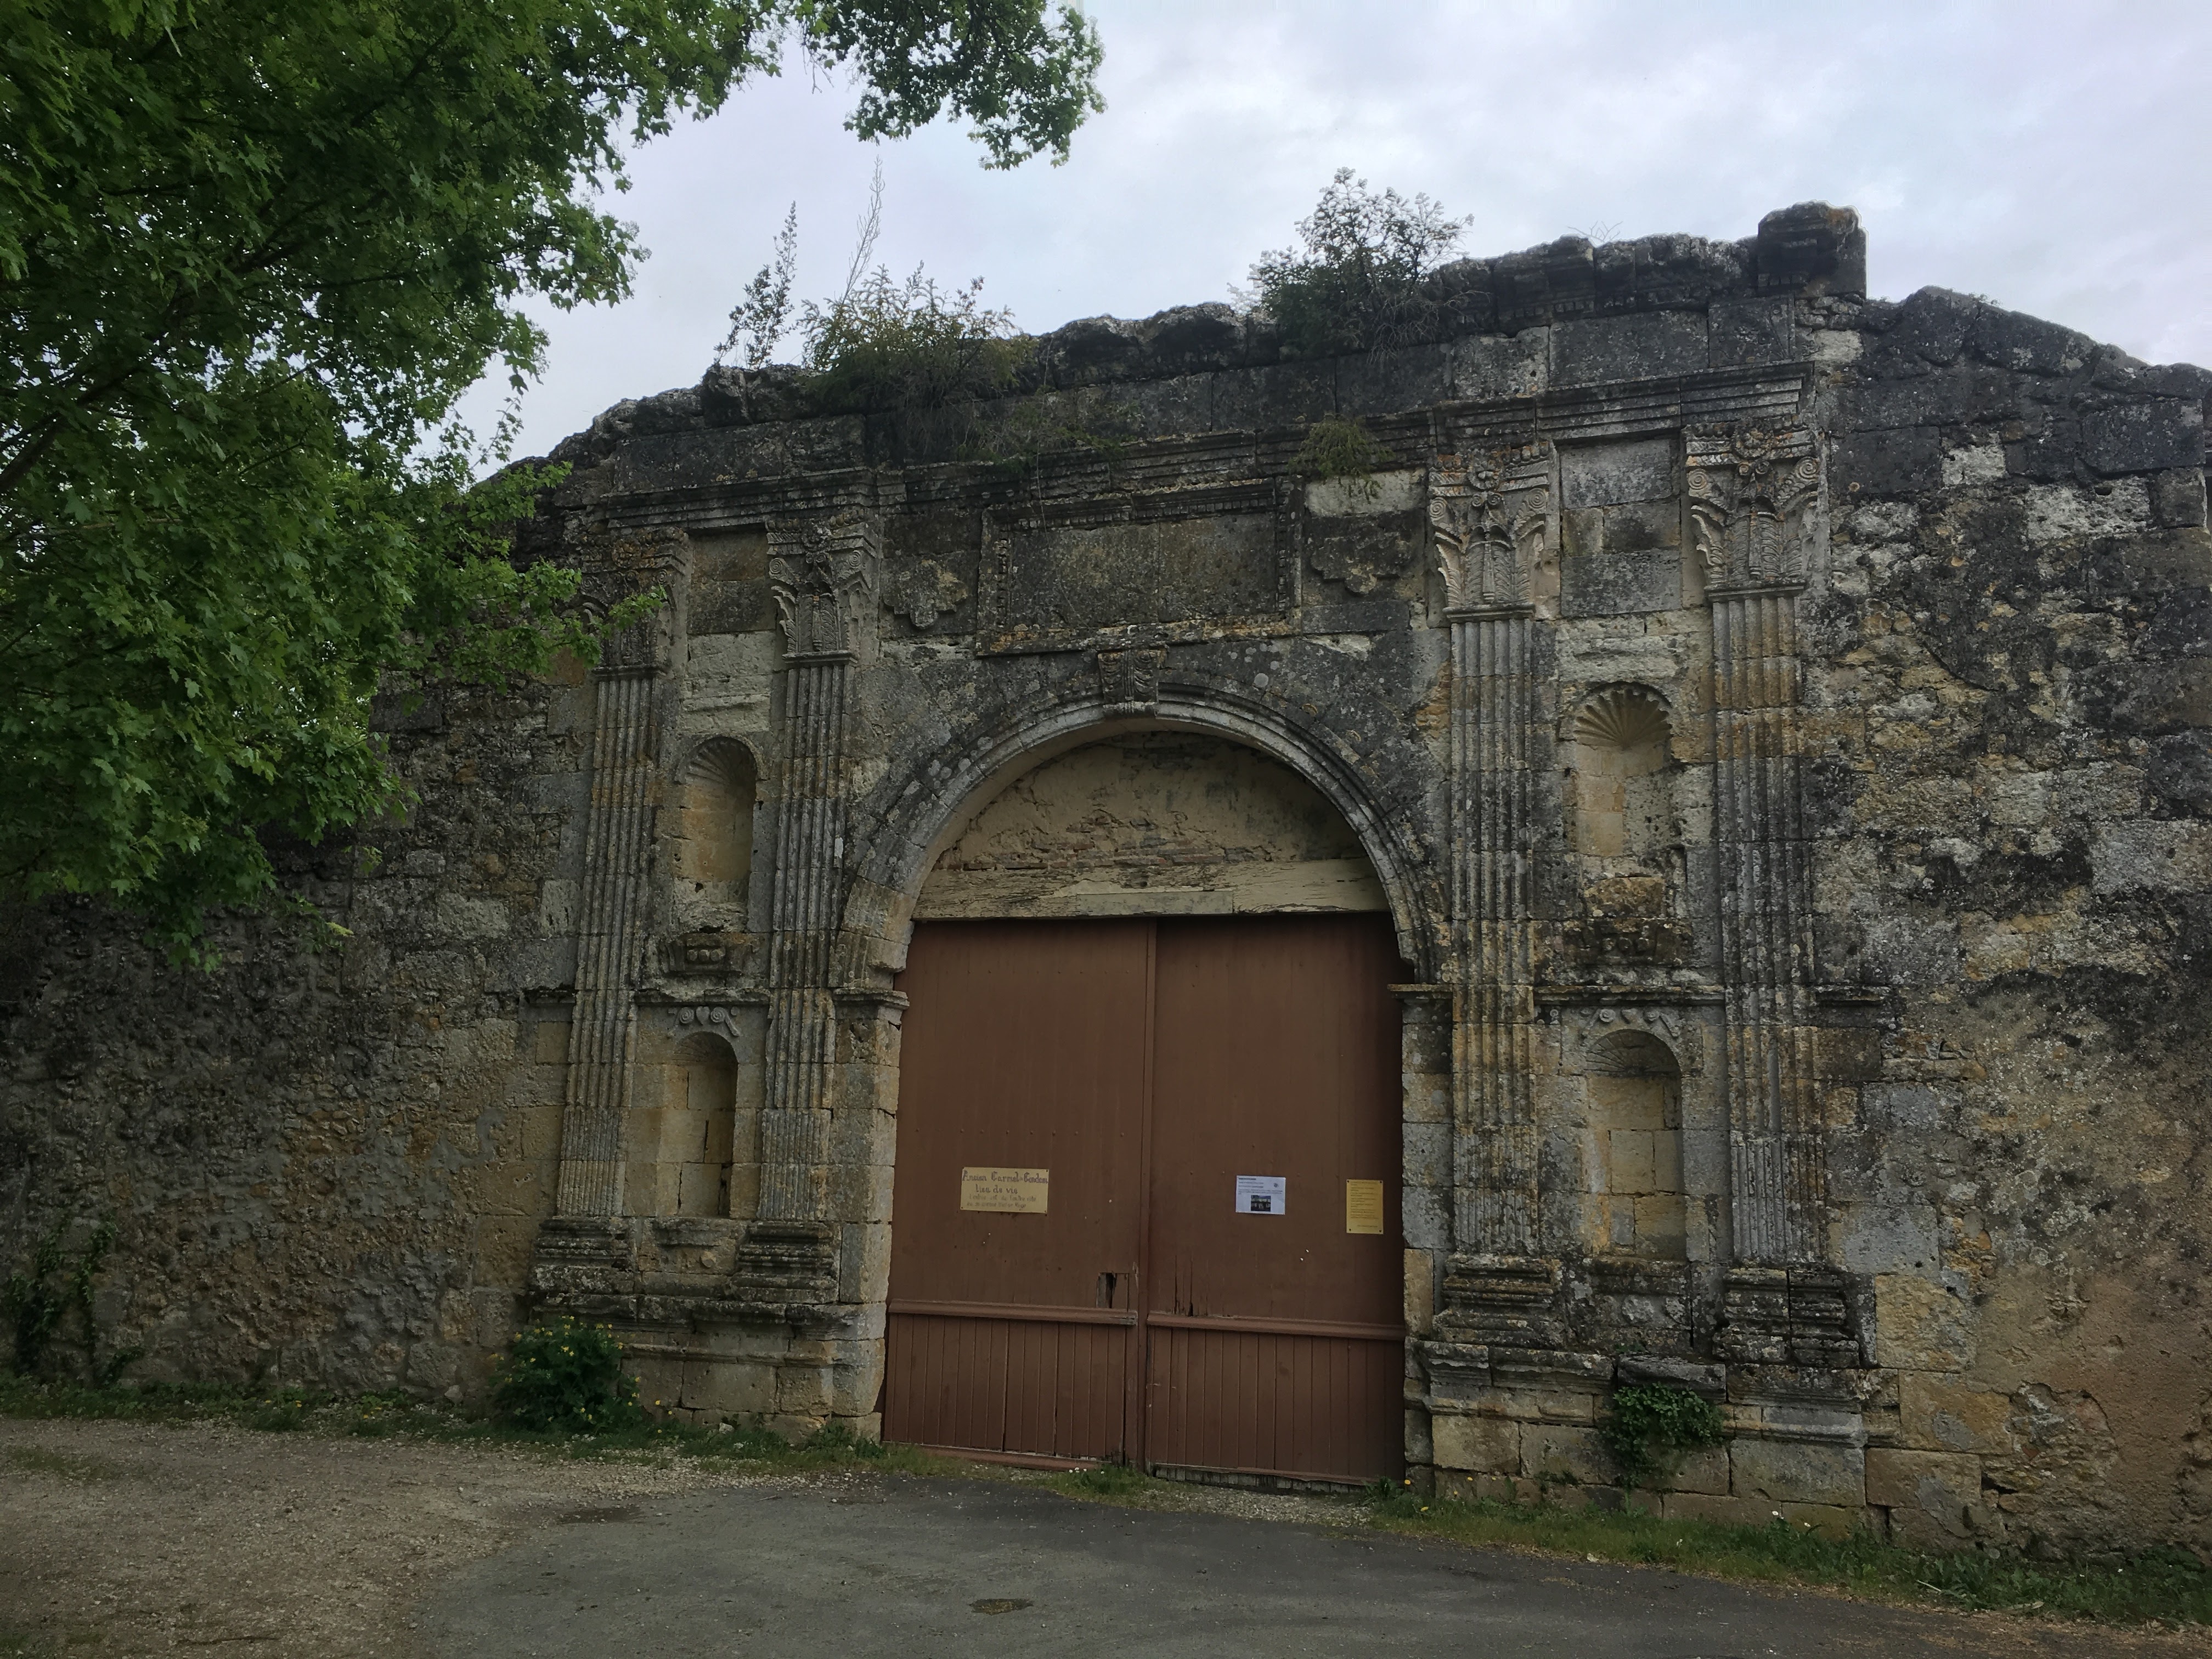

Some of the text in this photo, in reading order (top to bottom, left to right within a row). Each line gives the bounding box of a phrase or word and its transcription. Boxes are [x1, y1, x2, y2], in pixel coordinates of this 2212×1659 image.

[962, 1170, 986, 1181] Ancien
[991, 1171, 1019, 1182] Carmel
[1024, 1172, 1048, 1184] Condom
[993, 1184, 1003, 1193] de
